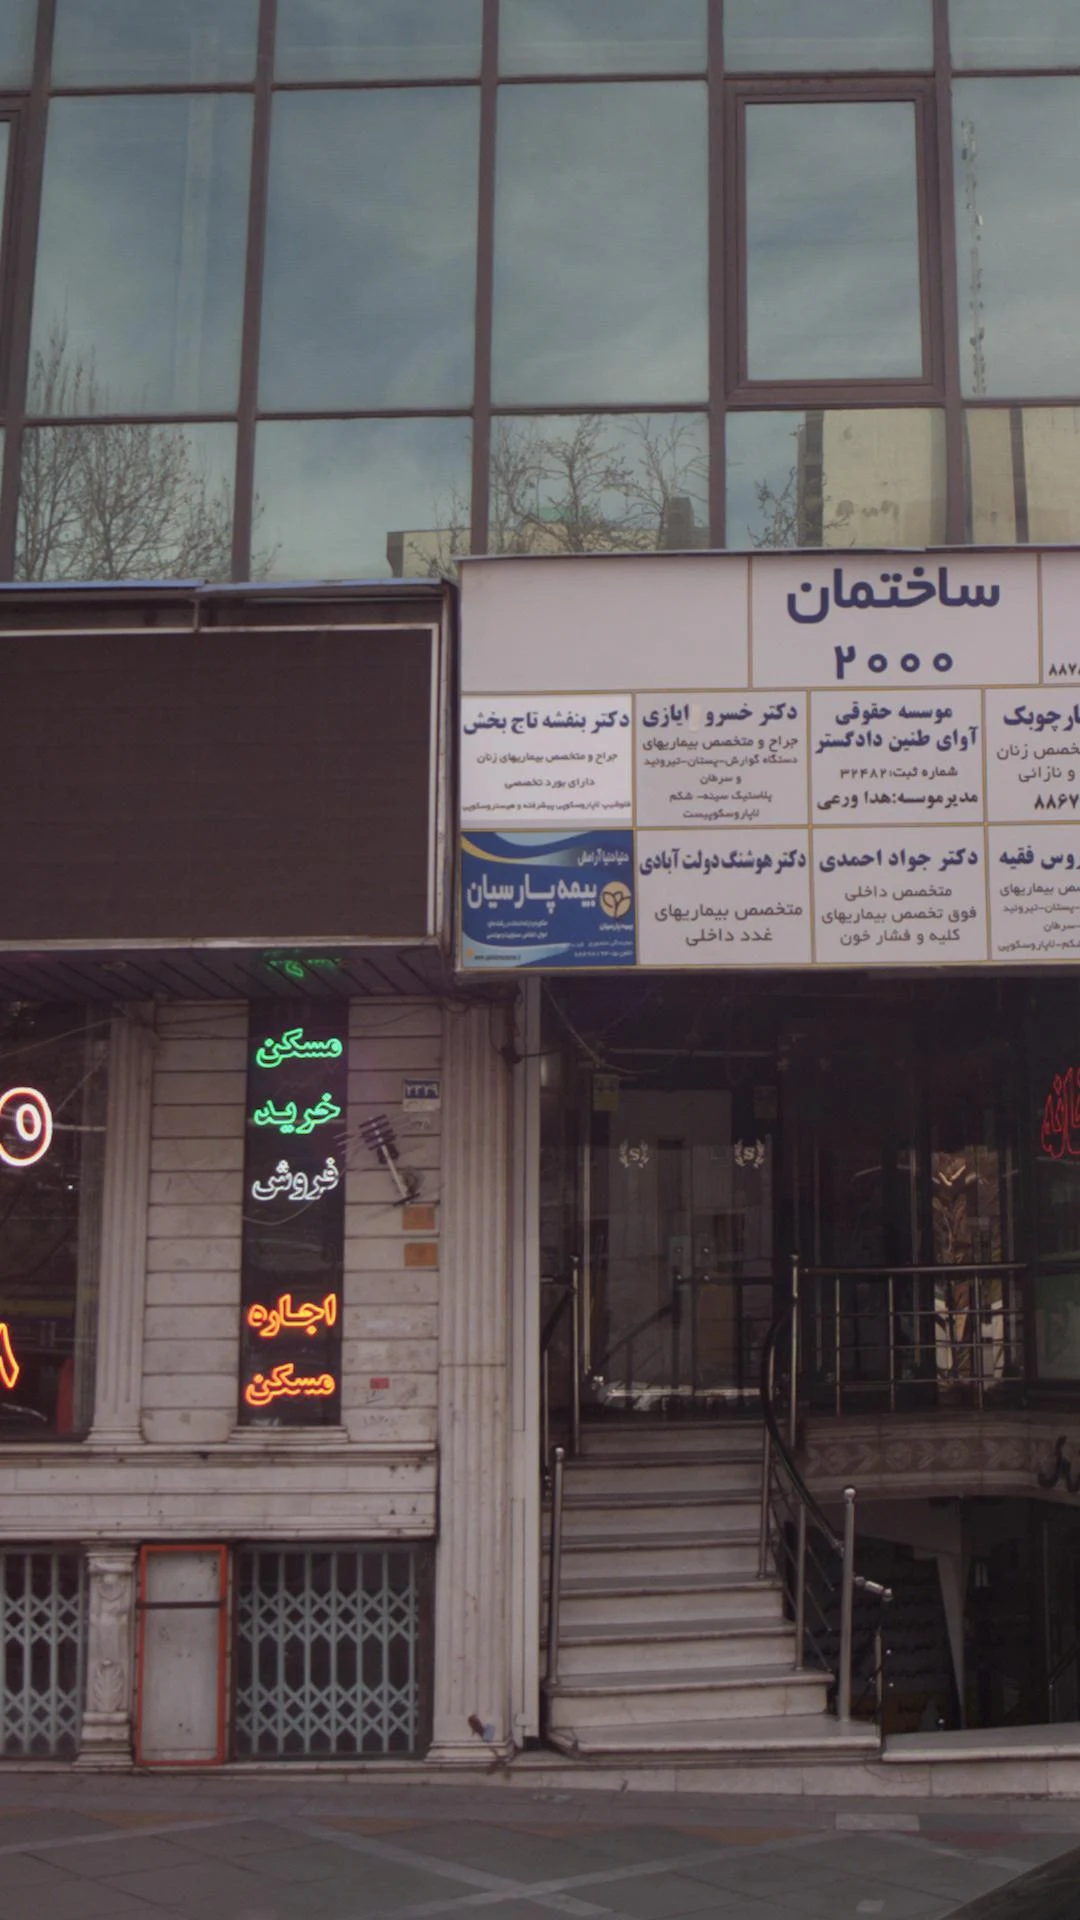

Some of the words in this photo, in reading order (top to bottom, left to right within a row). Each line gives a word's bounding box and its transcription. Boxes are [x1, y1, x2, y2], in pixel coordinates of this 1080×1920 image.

[787, 566, 1000, 624] ساختمان
[1049, 663, 1080, 676] ۸۸۷
[542, 710, 586, 733] بنفشه
[591, 710, 630, 734] دکتر
[642, 703, 689, 727] ایازی
[704, 703, 753, 727] خسرو
[758, 701, 798, 726] دکتر
[835, 701, 892, 725] حقوقی
[898, 704, 953, 724] موسسه
[1003, 705, 1062, 732] چوبک
[1062, 704, 1080, 731] ار
[463, 711, 507, 735] بخش
[511, 711, 538, 734] تاج
[642, 737, 699, 751] بیماریهای
[702, 737, 754, 750] متخصص
[758, 739, 764, 749] و
[769, 735, 798, 752] جراح
[815, 730, 882, 754] دادگستر
[888, 728, 930, 753] طنین
[936, 726, 979, 751] آوای
[476, 753, 498, 764] زنان
[499, 752, 544, 764] بیماریهای
[545, 752, 586, 763] متخصص
[587, 755, 594, 764] و
[595, 752, 618, 765] جراح
[763, 754, 798, 765] دستگاه
[996, 744, 1029, 760] زنان
[1034, 742, 1080, 760] خصص
[700, 773, 733, 785] سرطان
[736, 775, 742, 784] و
[922, 766, 958, 780] شماره
[1067, 769, 1075, 781] و
[504, 778, 543, 790] تخصصی
[545, 779, 566, 789] بورد
[568, 777, 595, 789] دارای
[669, 791, 693, 803] شکم
[731, 790, 773, 803] پلاستیک
[639, 848, 681, 875] آبادی
[681, 849, 720, 875] دولت
[721, 849, 773, 874] هوشنگ
[774, 849, 806, 874] دکتر
[819, 848, 882, 873] احمدی
[888, 849, 931, 872] جواد
[938, 848, 979, 872] دکتر
[998, 844, 1035, 870] فقیه
[467, 873, 555, 914] پارسیان
[558, 879, 597, 907] بیمه
[844, 885, 888, 902] داخلی
[892, 885, 952, 901] متخصص
[999, 882, 1054, 897] بیماریهای
[654, 903, 729, 922] بیماریهای
[734, 902, 803, 921] متخصص
[821, 907, 887, 924] بیماریهای
[891, 907, 943, 924] تخصص
[948, 905, 977, 923] فوق
[685, 928, 734, 947] داخلی
[740, 928, 773, 942] غدد
[840, 930, 871, 946] خون
[876, 928, 911, 945] فشار
[916, 932, 925, 945] و
[929, 928, 961, 943] کلیه
[255, 1027, 344, 1069] مسکن
[253, 1092, 341, 1135] خرید
[251, 1156, 340, 1201] فروش
[247, 1292, 338, 1338] اجاره
[244, 1362, 337, 1407] مسکن
